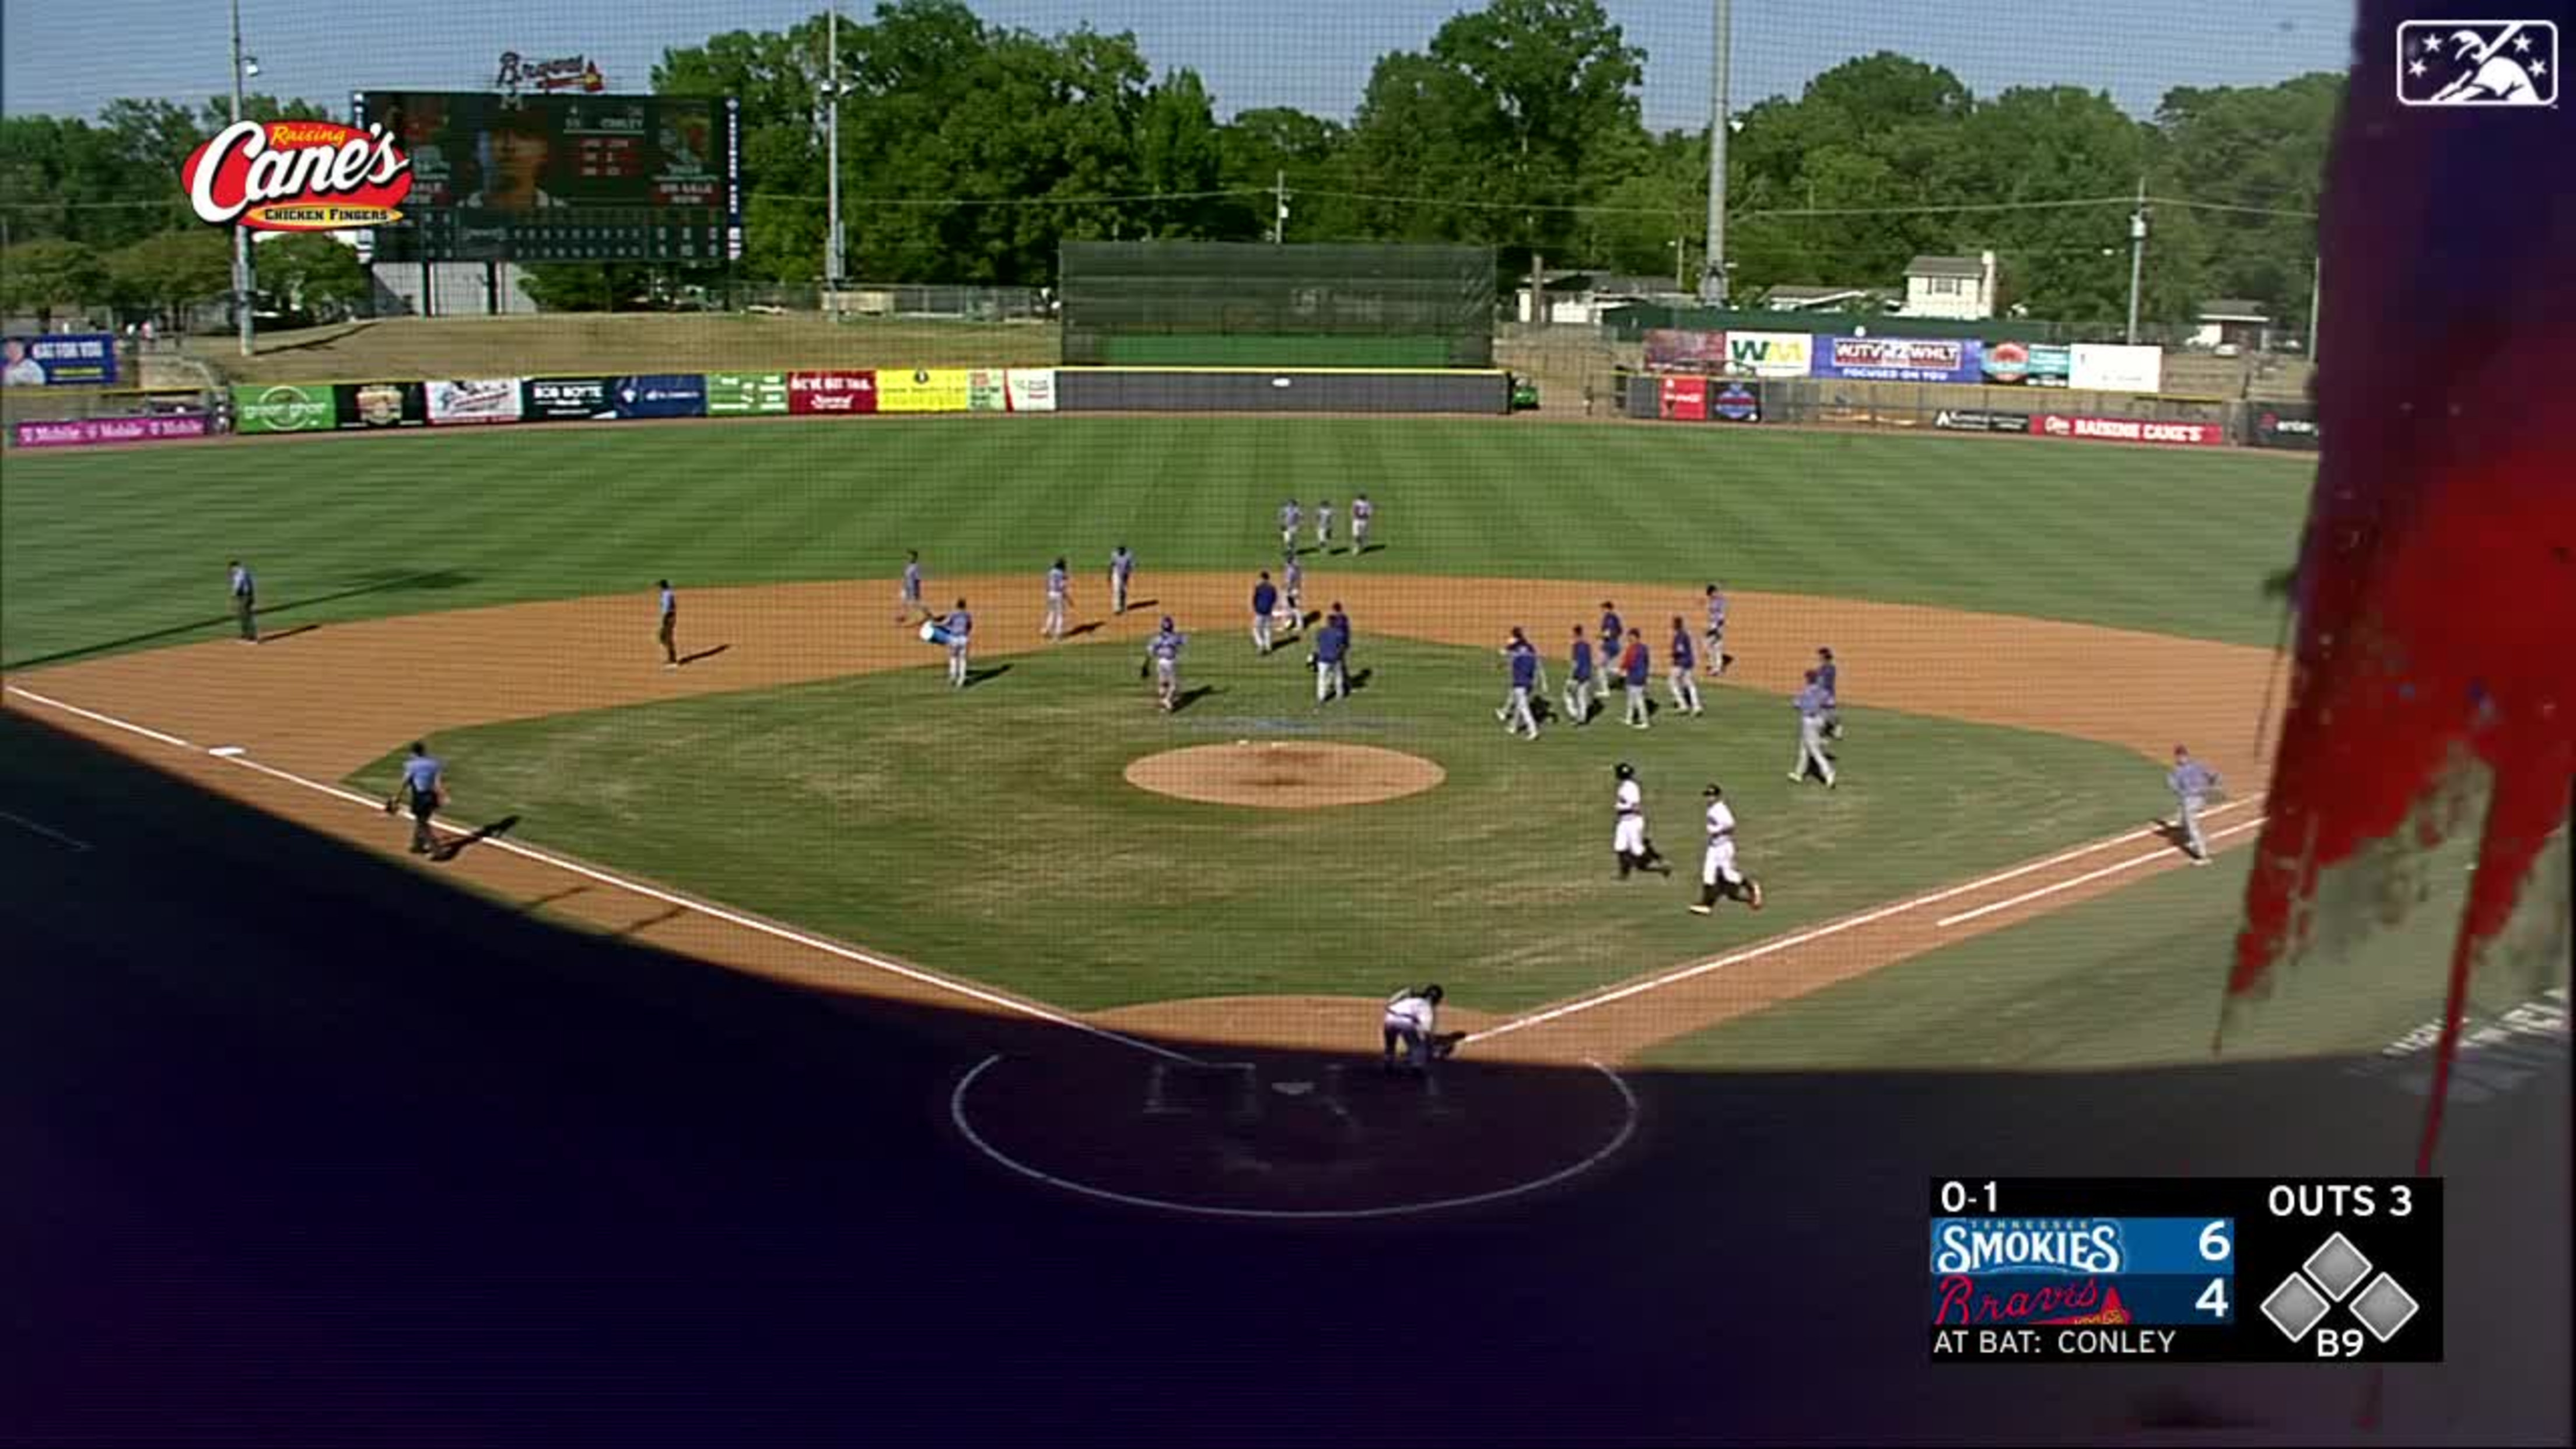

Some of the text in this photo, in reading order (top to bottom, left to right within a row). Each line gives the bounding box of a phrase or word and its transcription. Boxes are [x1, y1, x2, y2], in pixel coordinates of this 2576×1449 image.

[1842, 368, 1948, 380] FOCUSED ON YOU
